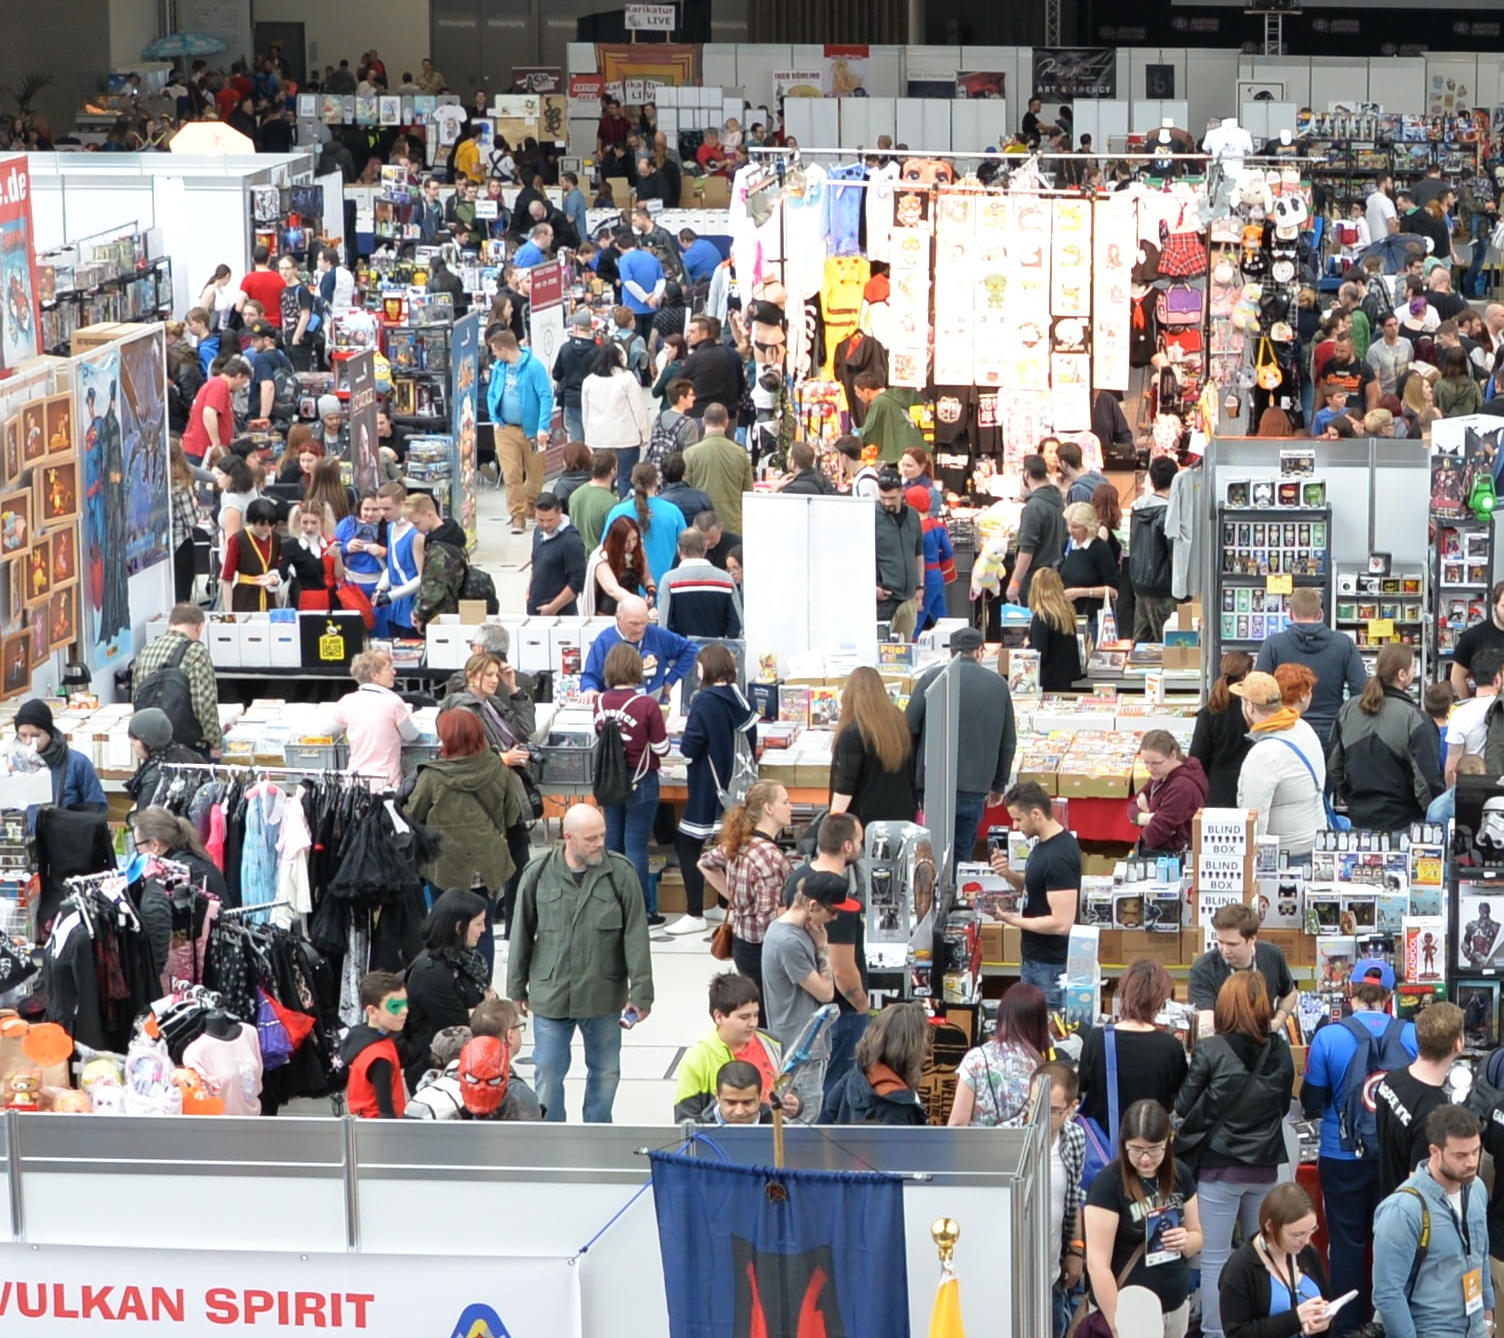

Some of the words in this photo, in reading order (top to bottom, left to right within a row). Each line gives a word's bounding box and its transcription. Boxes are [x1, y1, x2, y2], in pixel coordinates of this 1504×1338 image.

[647, 16, 671, 25] LIVE
[1207, 824, 1241, 835] BLIND
[1212, 844, 1237, 854] BOX
[1204, 860, 1239, 871] BLIND
[1210, 880, 1234, 890] BOX
[1204, 896, 1239, 907] BLIND
[204, 1287, 375, 1329] SPIRIT
